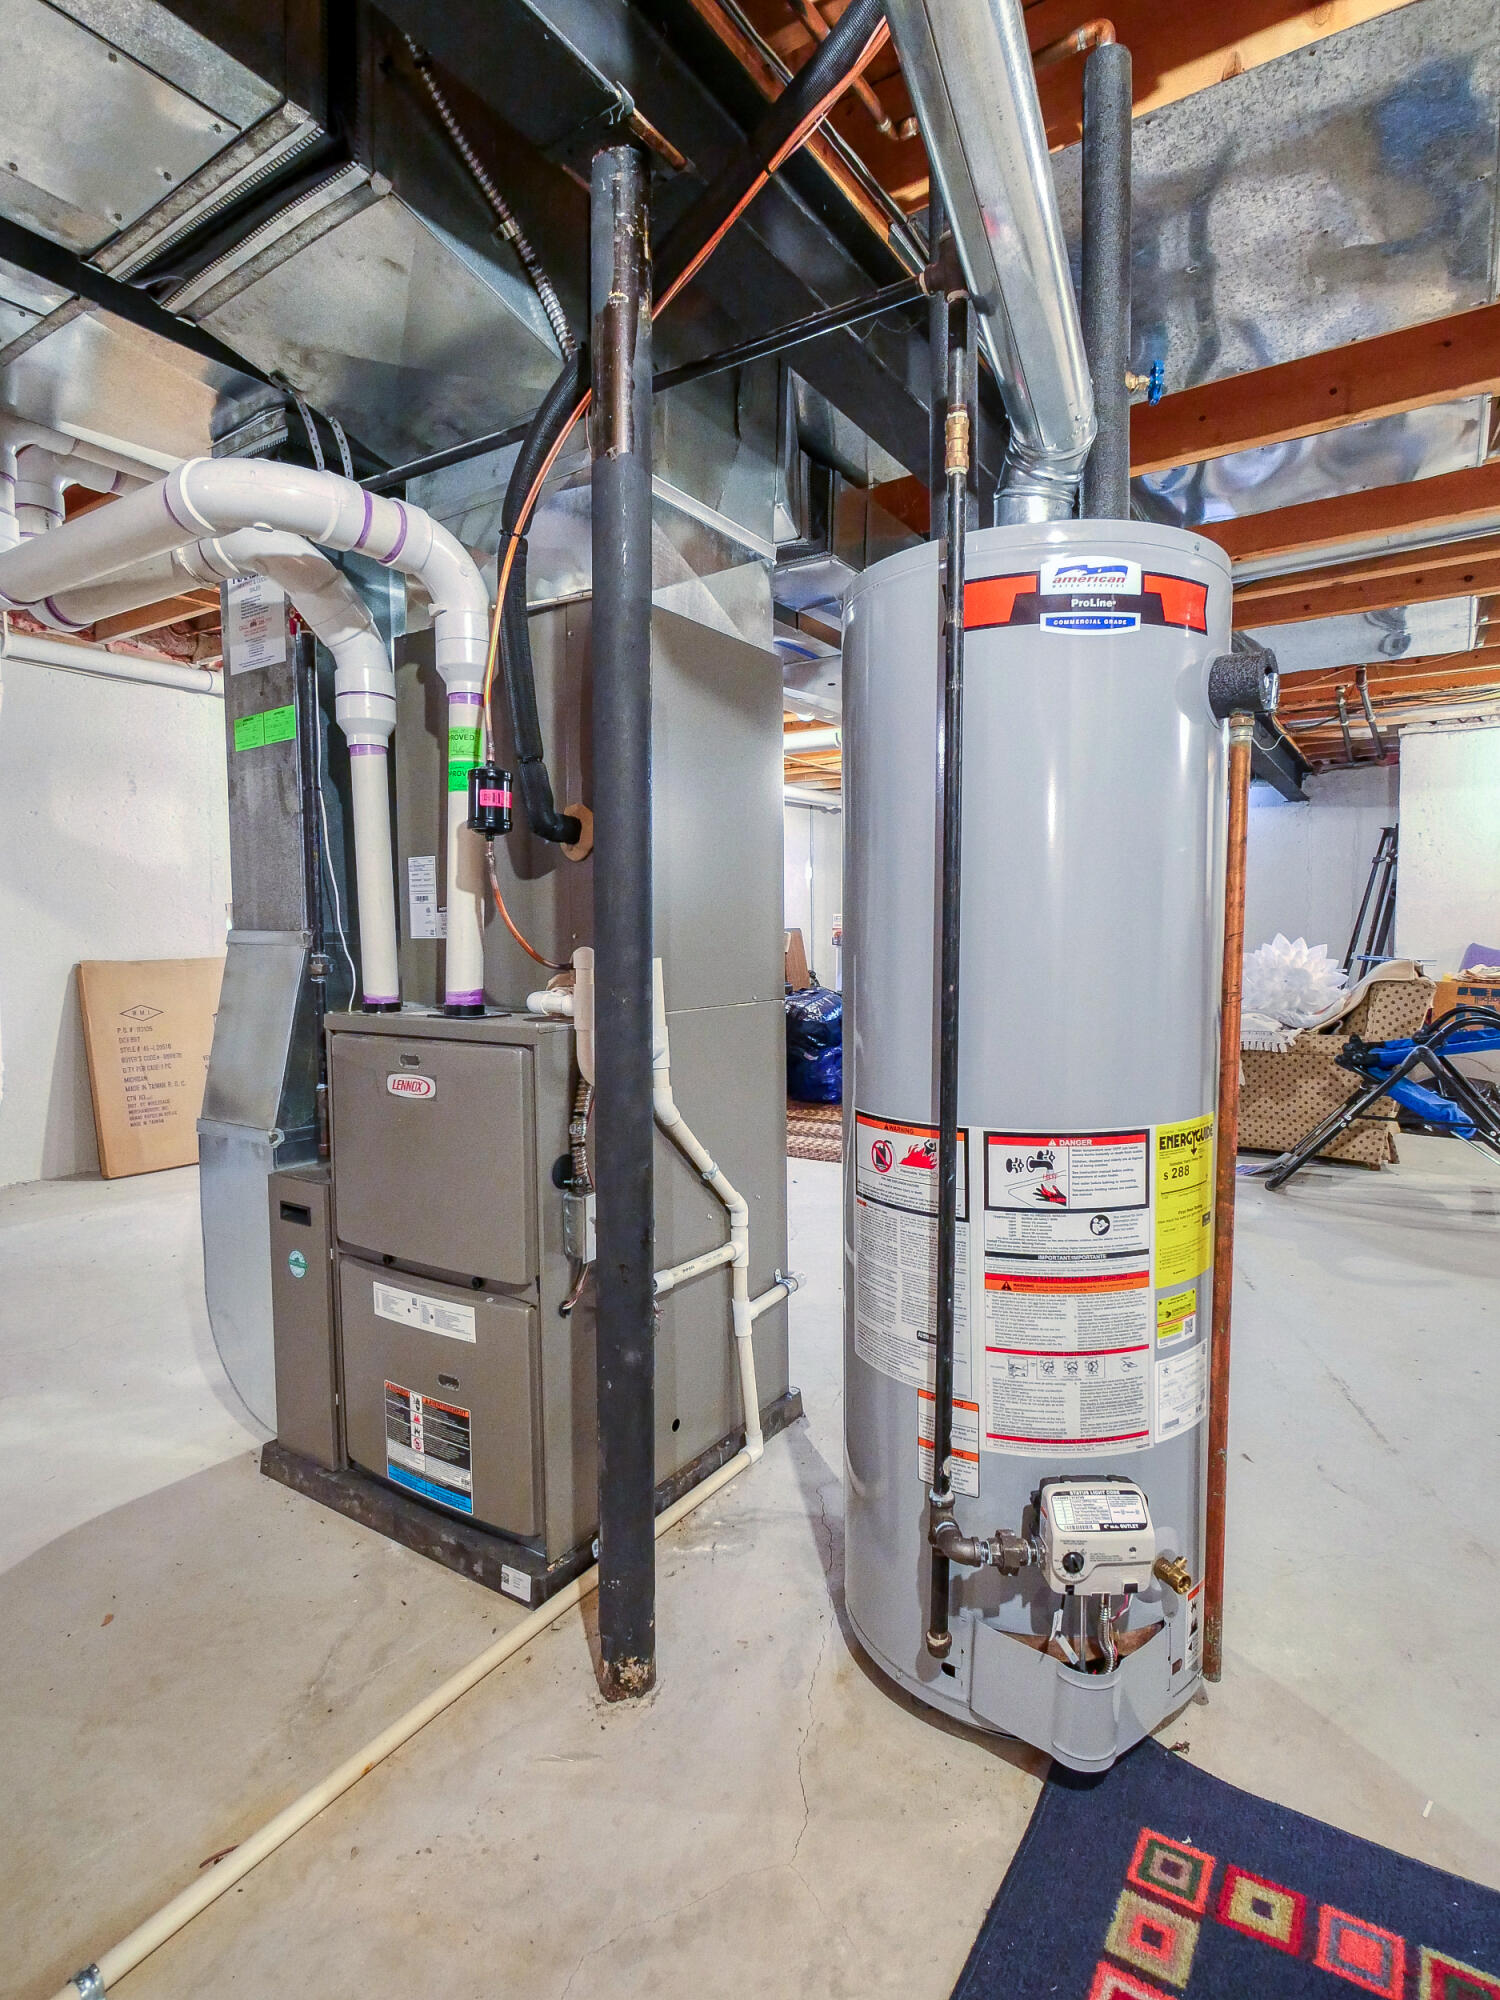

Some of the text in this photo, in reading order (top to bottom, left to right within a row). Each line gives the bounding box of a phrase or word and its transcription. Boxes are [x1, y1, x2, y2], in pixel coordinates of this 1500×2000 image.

[1052, 576, 1126, 584] american
[392, 1079, 423, 1092] LENNOX
[889, 1126, 914, 1135] WARNING
[1171, 1164, 1190, 1179] 288
